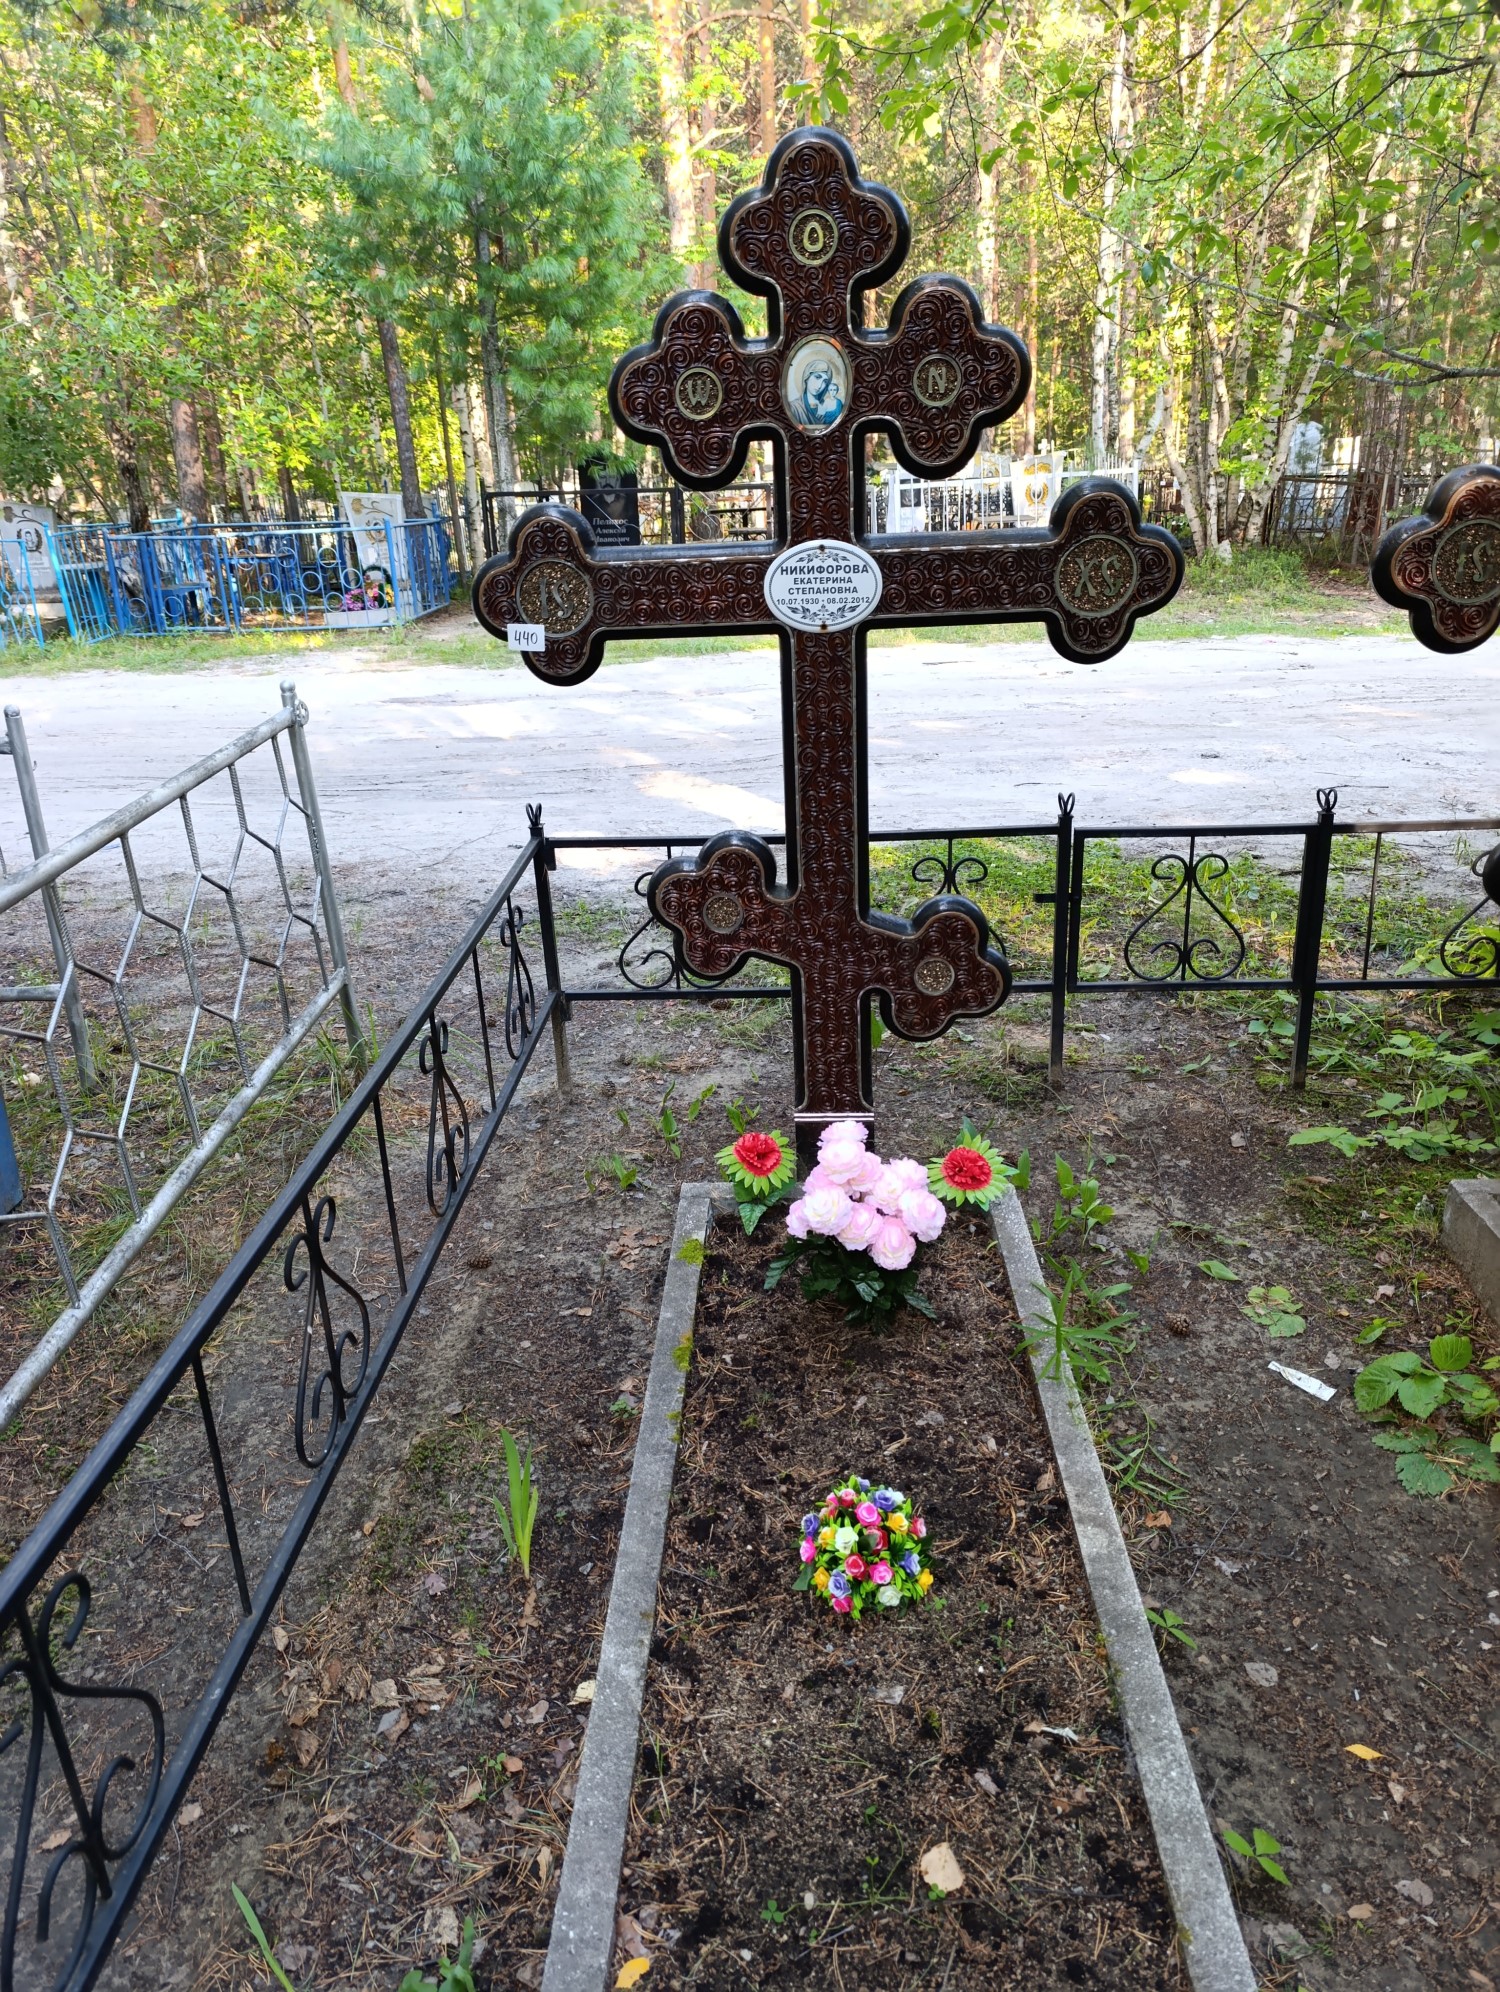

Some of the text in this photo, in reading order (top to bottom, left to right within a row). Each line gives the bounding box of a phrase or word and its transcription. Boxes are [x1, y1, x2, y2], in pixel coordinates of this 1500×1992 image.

[780, 564, 869, 576] НИКИФОРОВА
[793, 576, 853, 585] ЕКАТЕРИНА
[788, 586, 858, 596] СТЕПАНОВНА
[826, 596, 870, 604] 08.02.2012
[514, 632, 538, 646] 440
